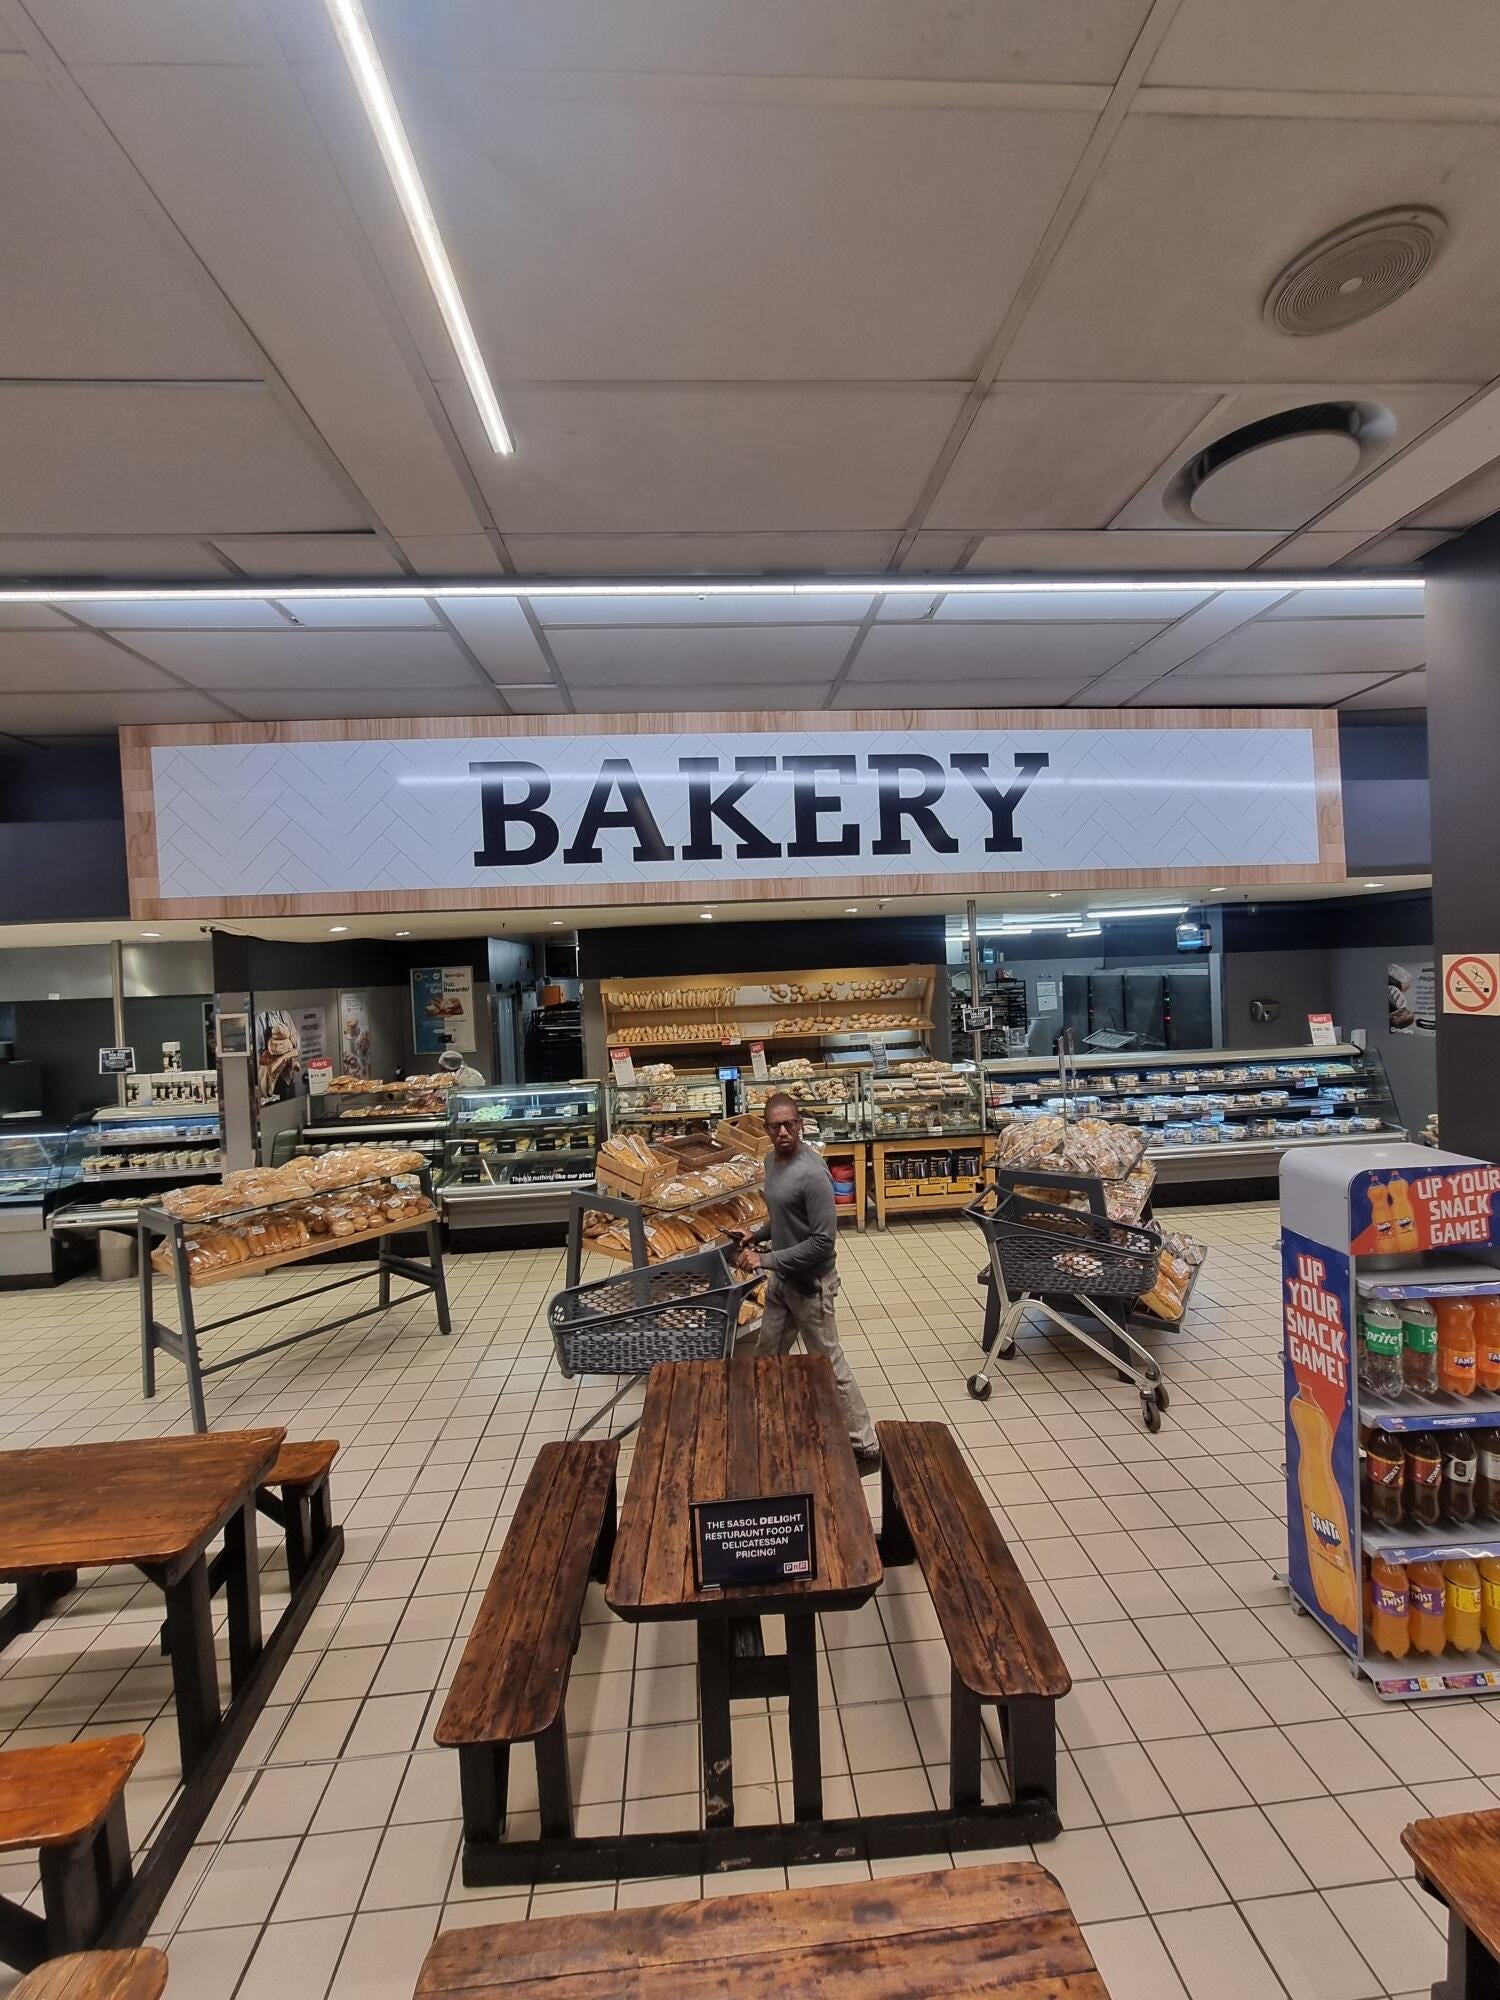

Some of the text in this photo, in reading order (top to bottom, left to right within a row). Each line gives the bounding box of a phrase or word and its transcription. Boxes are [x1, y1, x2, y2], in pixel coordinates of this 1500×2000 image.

[469, 753, 1049, 866] BAKERY
[533, 1173, 555, 1182] nothing
[1417, 1170, 1500, 1200] UP YOUR
[1429, 1194, 1490, 1221] SNACK
[1430, 1218, 1488, 1244] GAME!
[1299, 1257, 1323, 1286] UP
[1289, 1280, 1340, 1324] YOUR
[1287, 1307, 1345, 1359] SNACK
[1366, 1328, 1398, 1345] prite
[1290, 1336, 1345, 1387] GAME!
[705, 1524, 804, 1541] RESTURAUNT FOOD AT
[707, 1513, 801, 1529] THE SASOL DELIGHT
[1310, 1511, 1341, 1541] FANTA
[722, 1536, 788, 1550] DELICATESSAN
[735, 1547, 776, 1559] PRICING!
[1381, 1595, 1405, 1607] TWIST
[1411, 1592, 1432, 1603] TWIST
